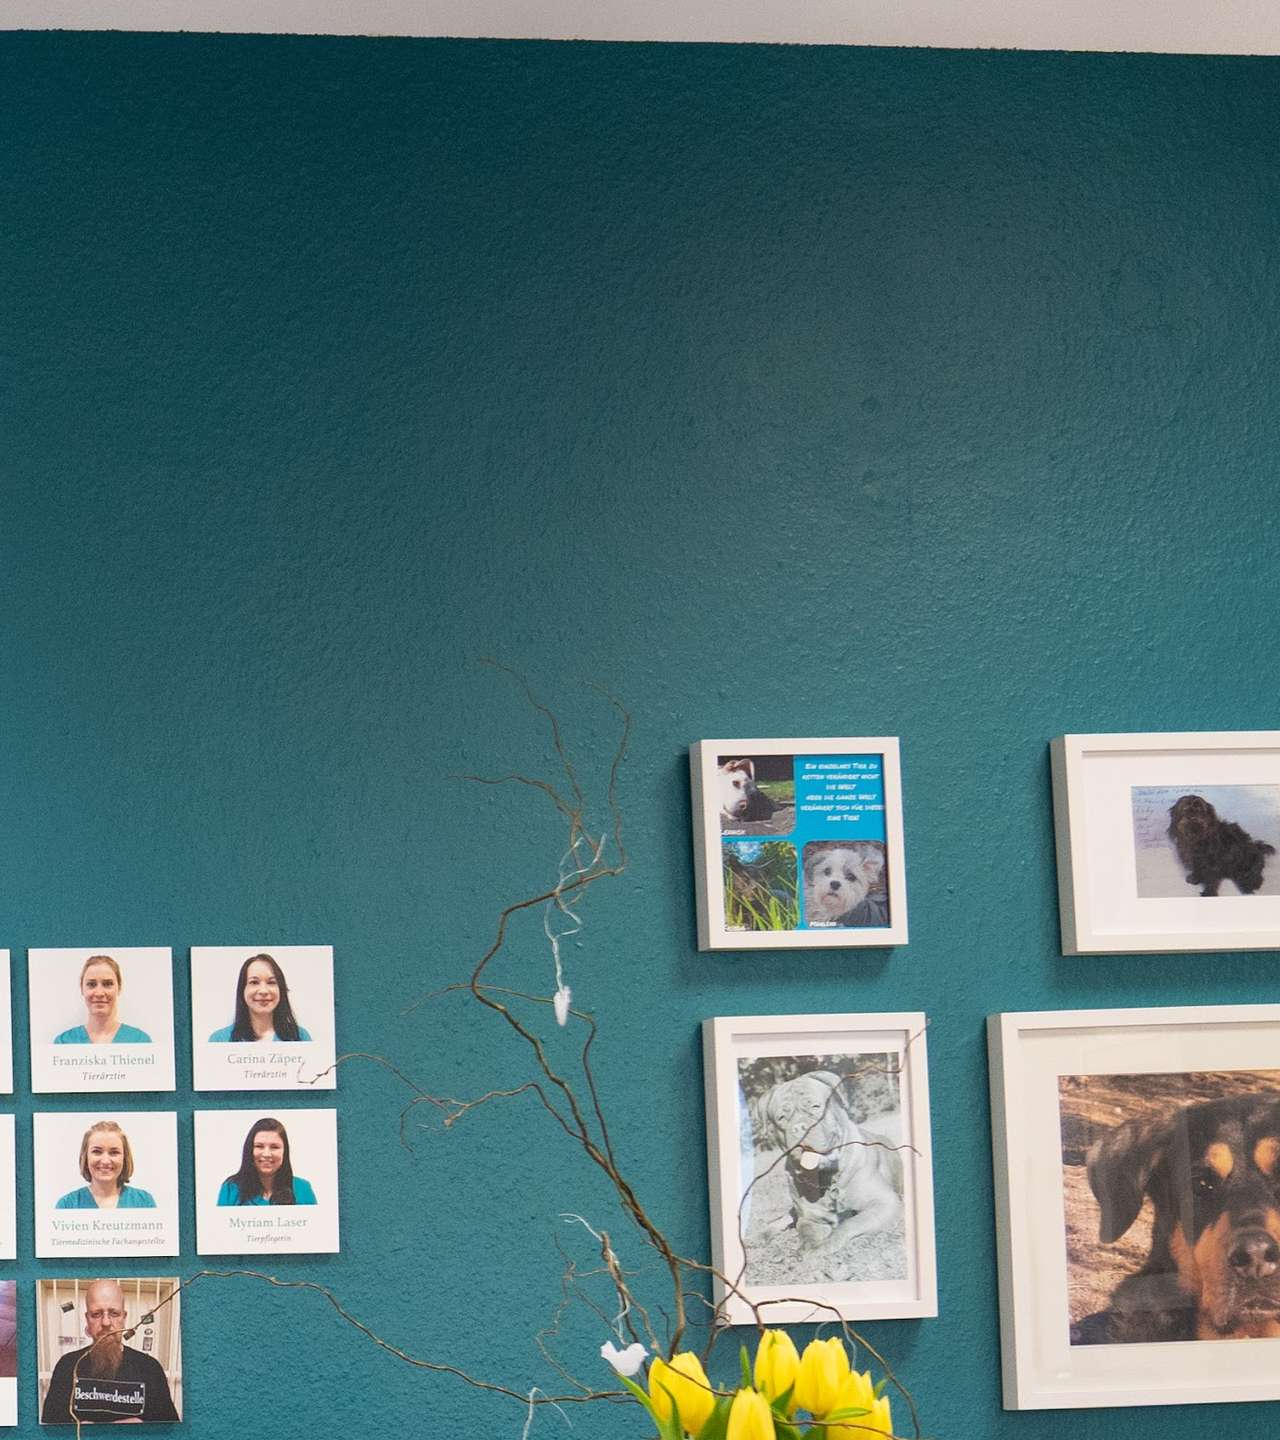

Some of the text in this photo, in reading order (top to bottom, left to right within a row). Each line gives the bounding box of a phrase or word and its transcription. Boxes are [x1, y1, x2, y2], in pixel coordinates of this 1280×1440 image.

[52, 1054, 155, 1066] Franziska Thienel
[227, 1053, 303, 1067] Carina Zäper
[82, 1070, 126, 1081] Tierärztin
[244, 1069, 287, 1079] Tierärztin
[52, 1219, 164, 1232] Vivien Kreutzmann
[229, 1217, 307, 1231] Myriam Laser
[74, 1387, 145, 1405] Beschwerdestelle
